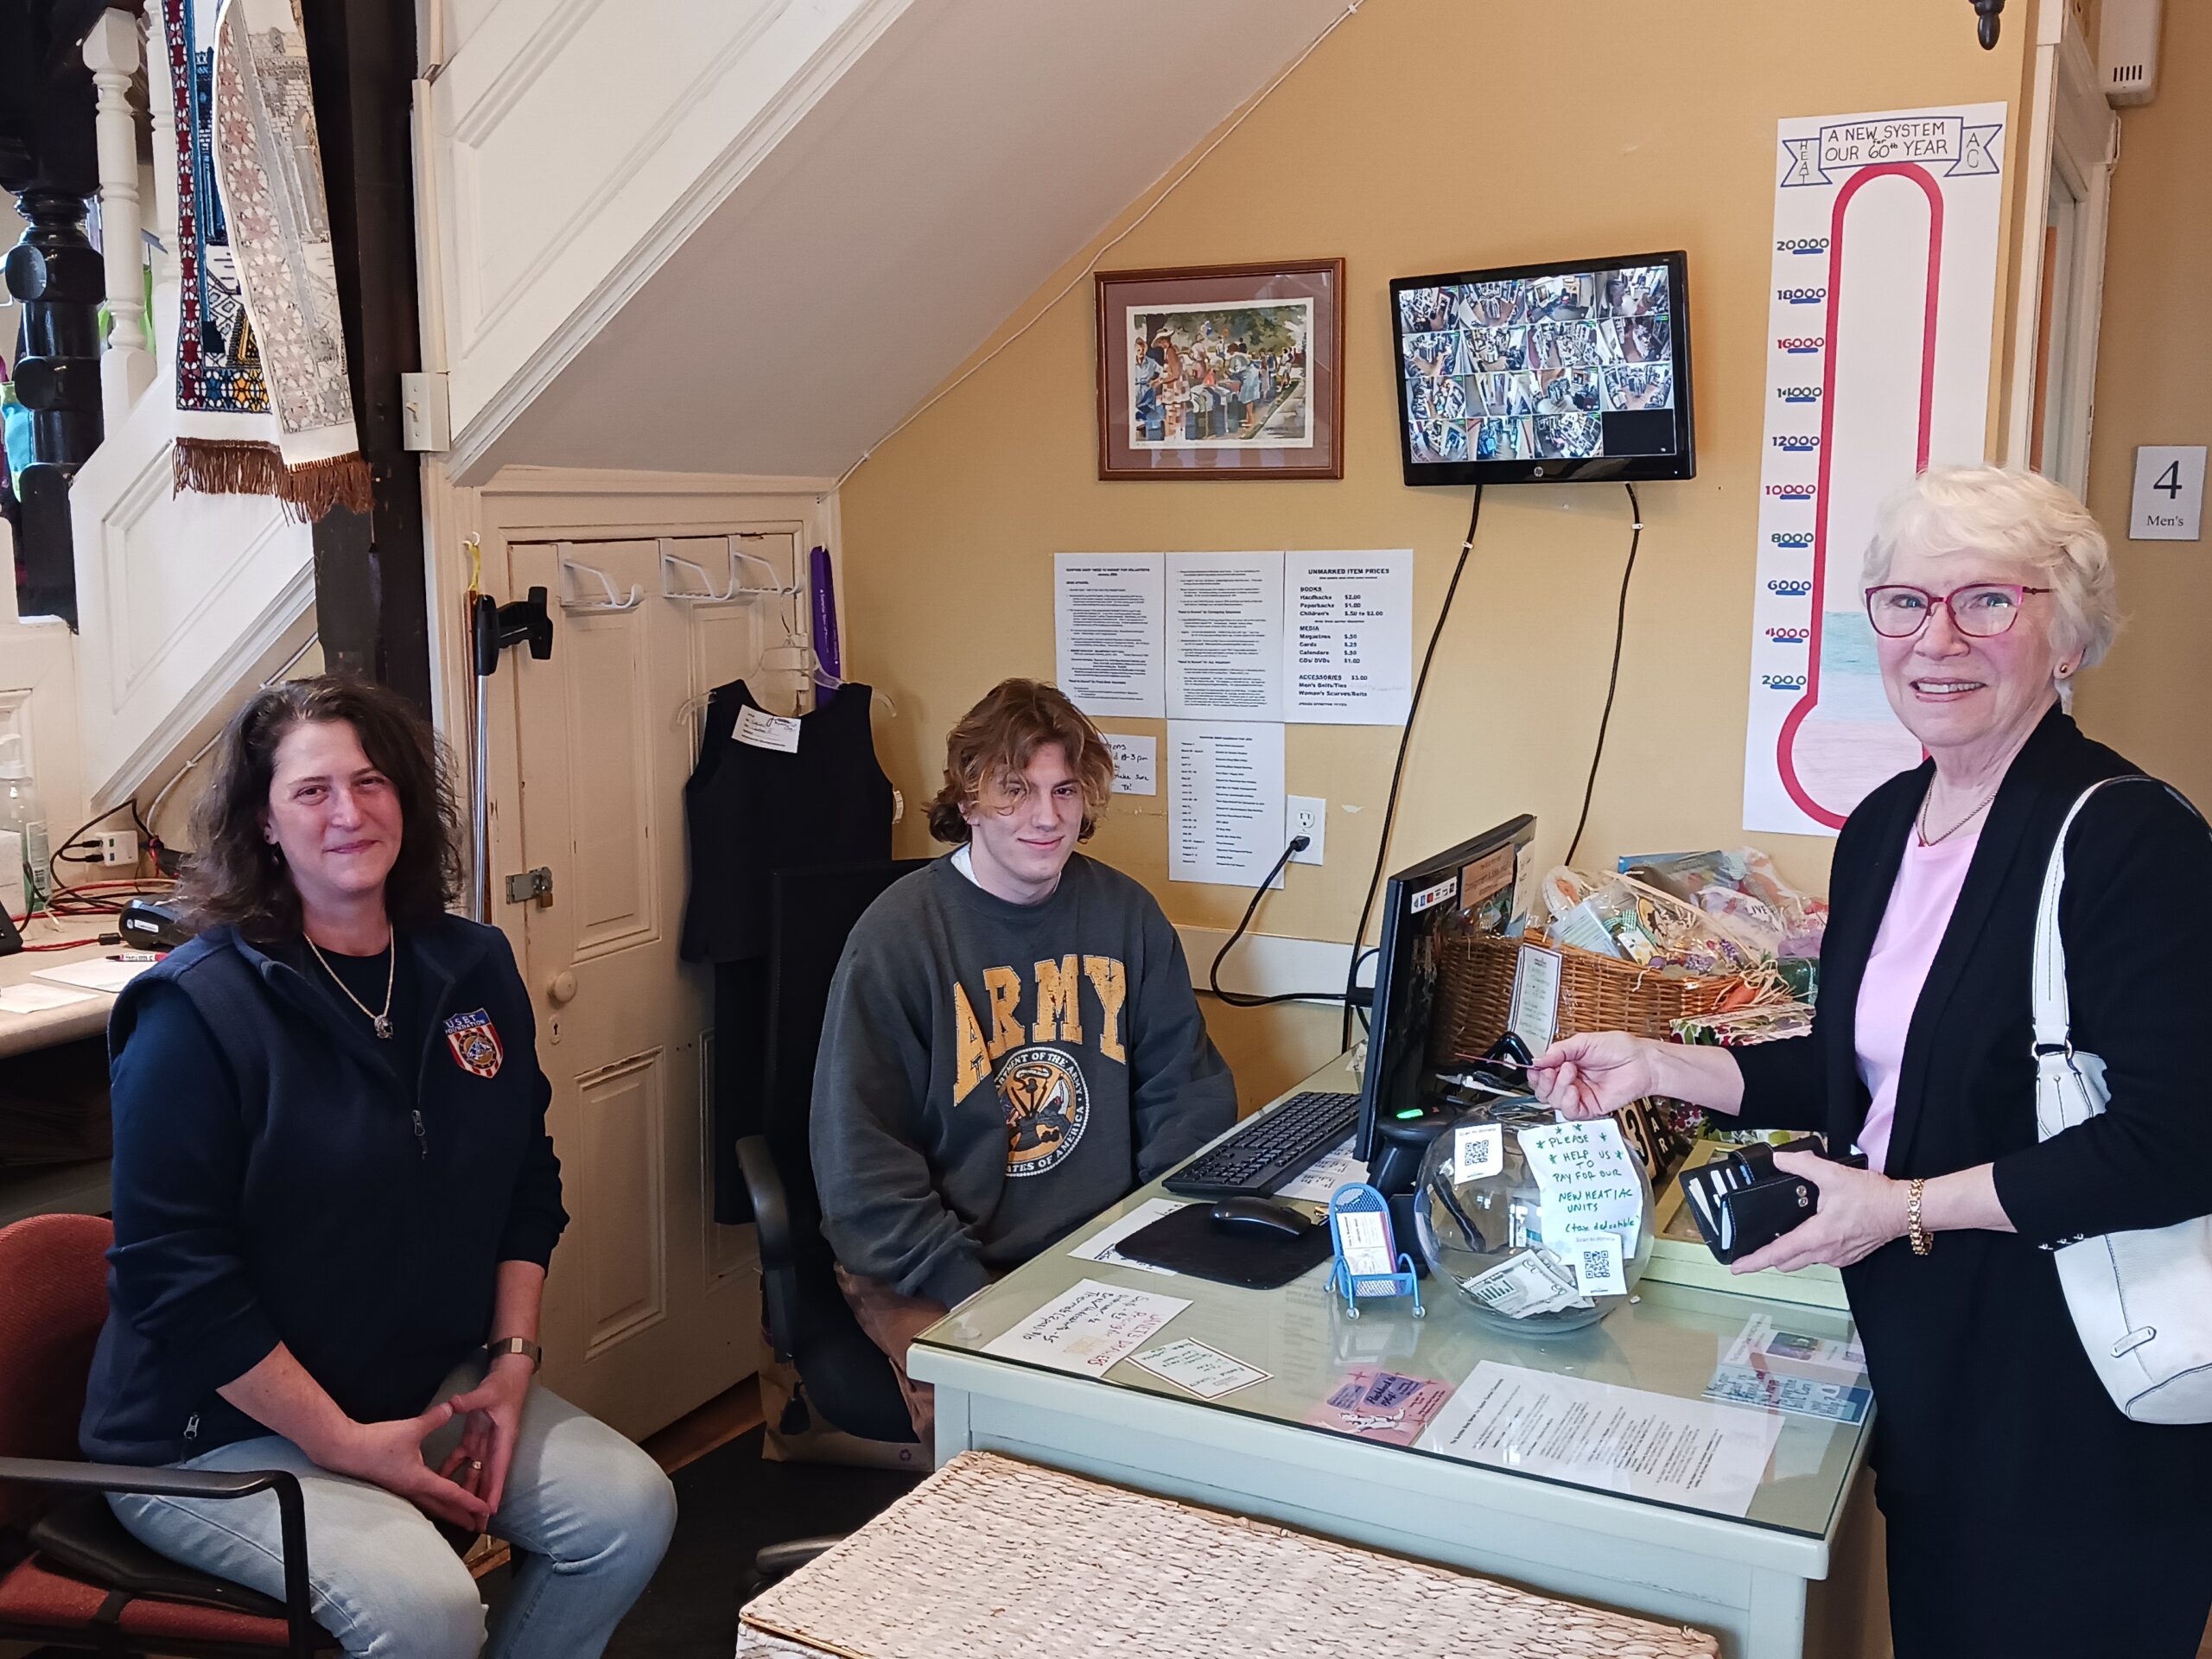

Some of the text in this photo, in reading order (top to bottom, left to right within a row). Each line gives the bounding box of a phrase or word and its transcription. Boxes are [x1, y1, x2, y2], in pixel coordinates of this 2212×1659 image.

[1827, 121, 1946, 142] A NEW SYSTEM
[1825, 138, 1948, 162] OUR 60th YEAR
[1798, 140, 1810, 185] HEAT
[2152, 460, 2183, 499] 4
[2146, 515, 2184, 526] Men's
[445, 1019, 486, 1034] FOUNDATION
[953, 953, 1126, 1107] ARMY
[1031, 1052, 1046, 1061] OF
[1047, 1053, 1069, 1067] THE
[1066, 1065, 1083, 1095] ARMY
[1038, 1156, 1053, 1168] OF
[1056, 1105, 1084, 1159] AMERICA
[1548, 1135, 1590, 1147] PLEASE
[1563, 1149, 1611, 1162] HELP US
[1575, 1160, 1595, 1170] TO
[1552, 1168, 1623, 1184] PAY FOR OUR
[1559, 1191, 1582, 1202] NEW
[1567, 1203, 1599, 1213] UNITS
